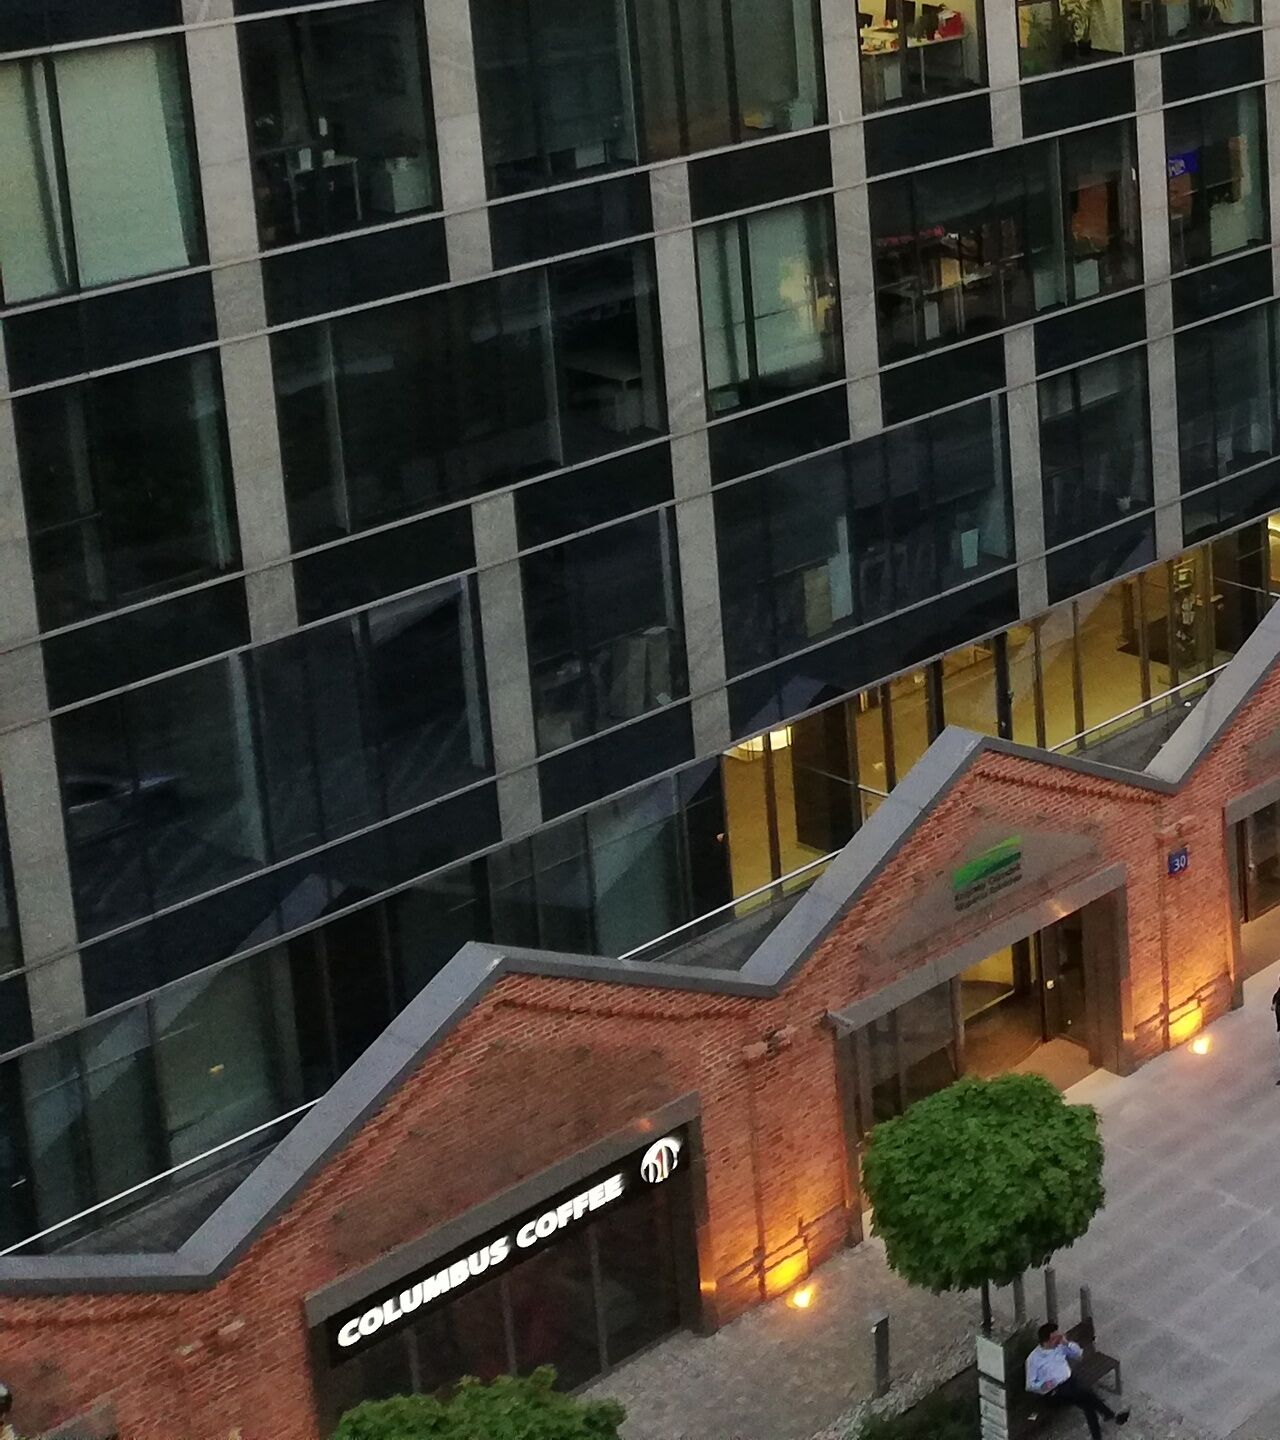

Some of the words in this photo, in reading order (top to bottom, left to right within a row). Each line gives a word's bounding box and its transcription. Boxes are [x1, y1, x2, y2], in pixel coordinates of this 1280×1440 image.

[1173, 855, 1186, 871] 30
[337, 1235, 511, 1347] COLUMBUS
[516, 1172, 626, 1248] COFFEE
